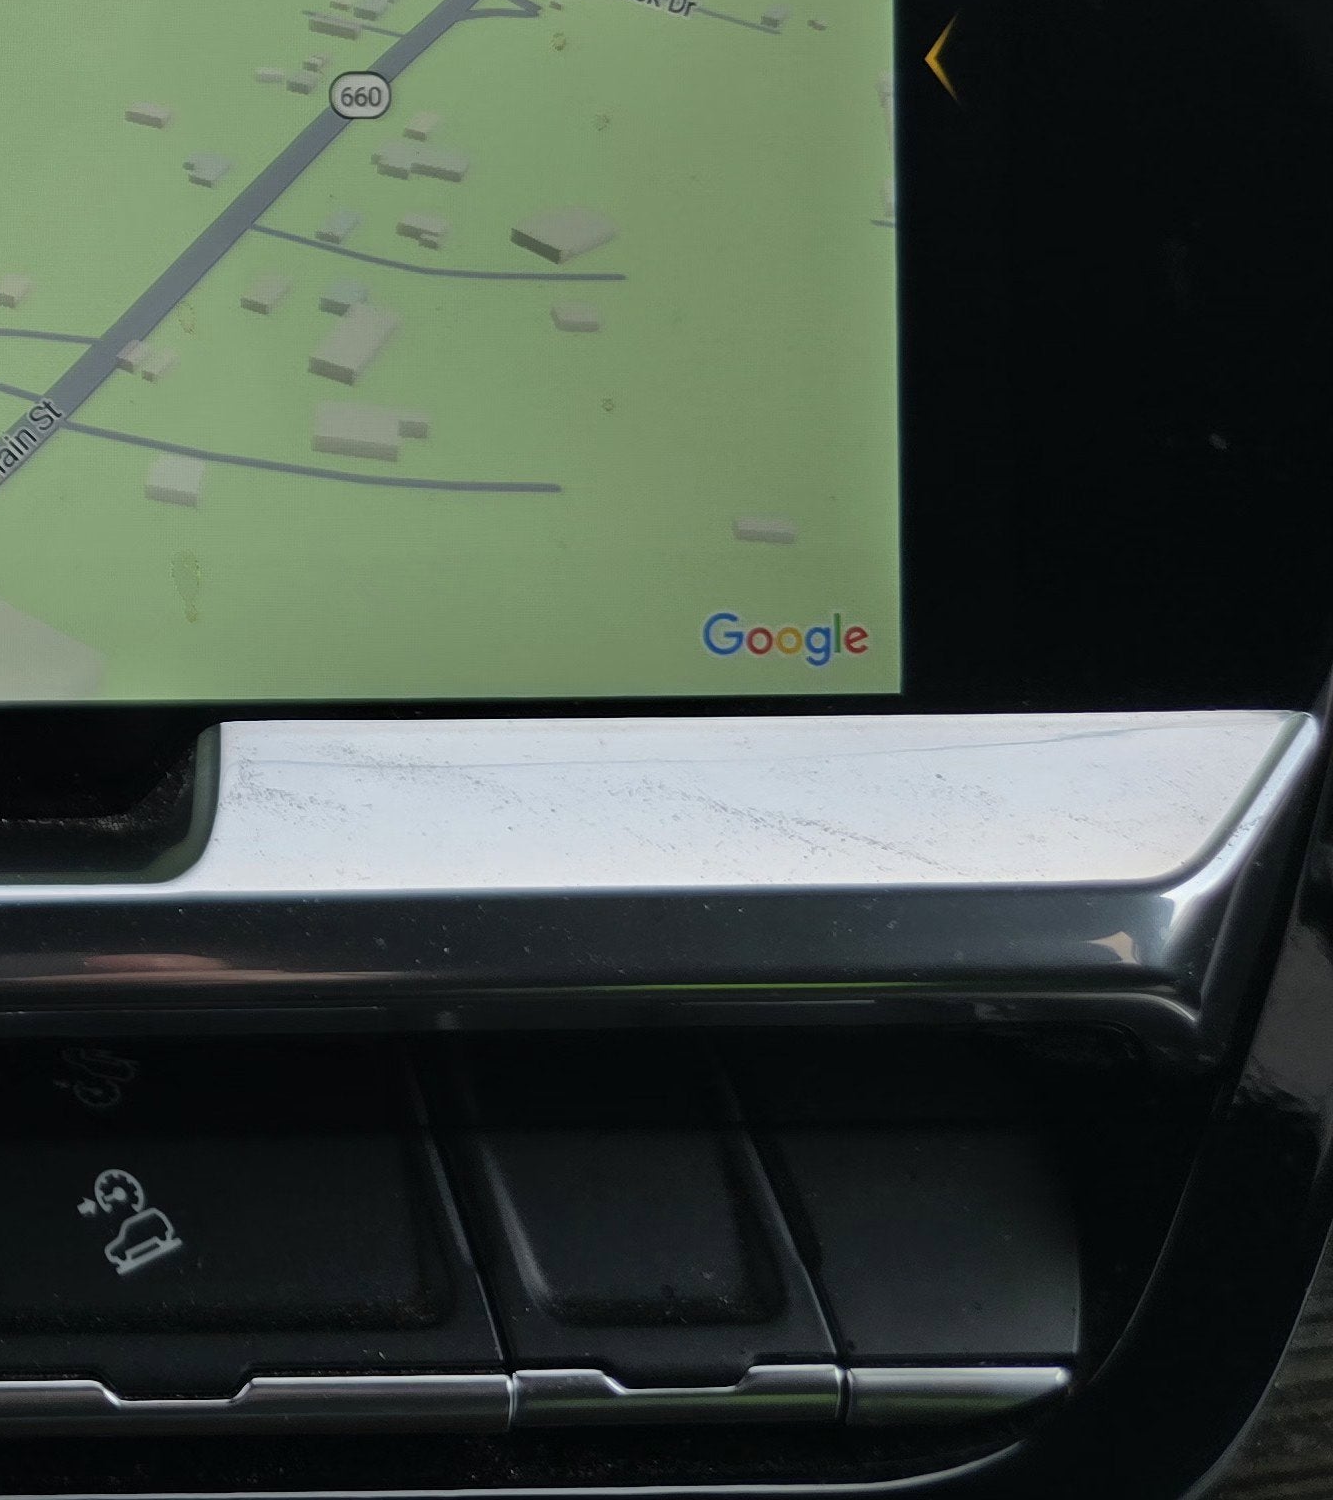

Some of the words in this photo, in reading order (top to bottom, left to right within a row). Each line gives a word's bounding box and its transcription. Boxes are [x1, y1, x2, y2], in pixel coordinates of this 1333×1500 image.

[339, 86, 383, 108] 660
[28, 400, 63, 431] St
[703, 612, 869, 666] Google
